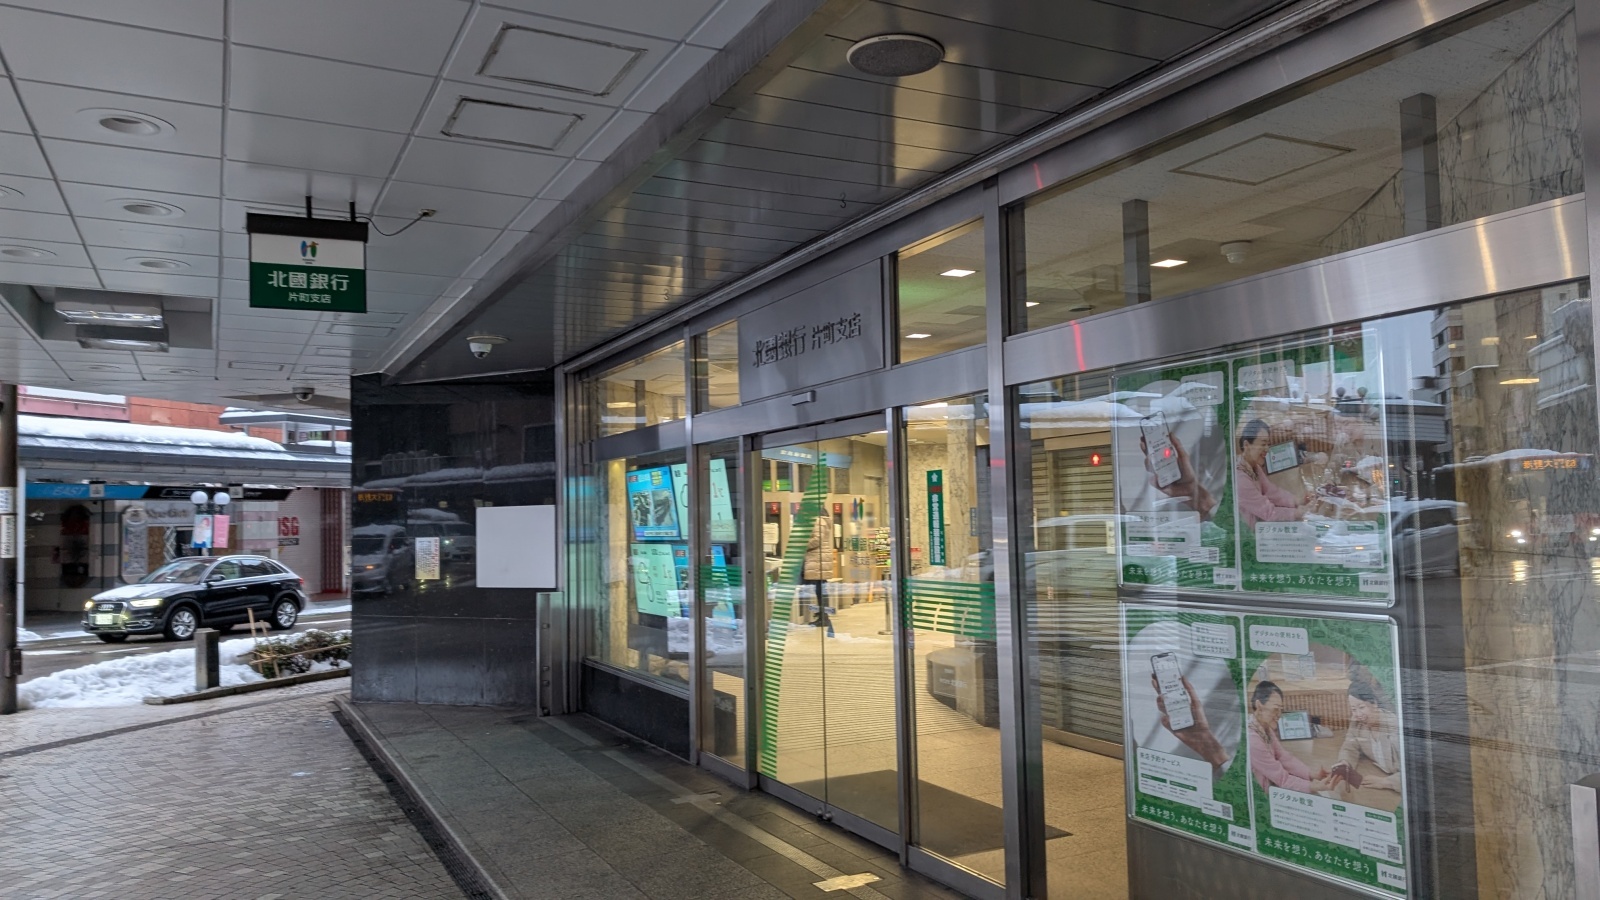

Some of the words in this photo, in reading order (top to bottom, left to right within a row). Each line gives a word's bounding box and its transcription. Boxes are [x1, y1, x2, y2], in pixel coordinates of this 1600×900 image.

[267, 270, 350, 291] 北國銀行
[288, 292, 332, 304] 片町支店
[752, 325, 807, 368] 北國銀行
[811, 312, 862, 350] 片町支店
[1250, 573, 1356, 587] 未来を想う、あなたを想う。
[1142, 804, 1226, 837] 未来を想う、あなたを想う。
[1264, 837, 1375, 877] 未来を想う、あなたを想う。
